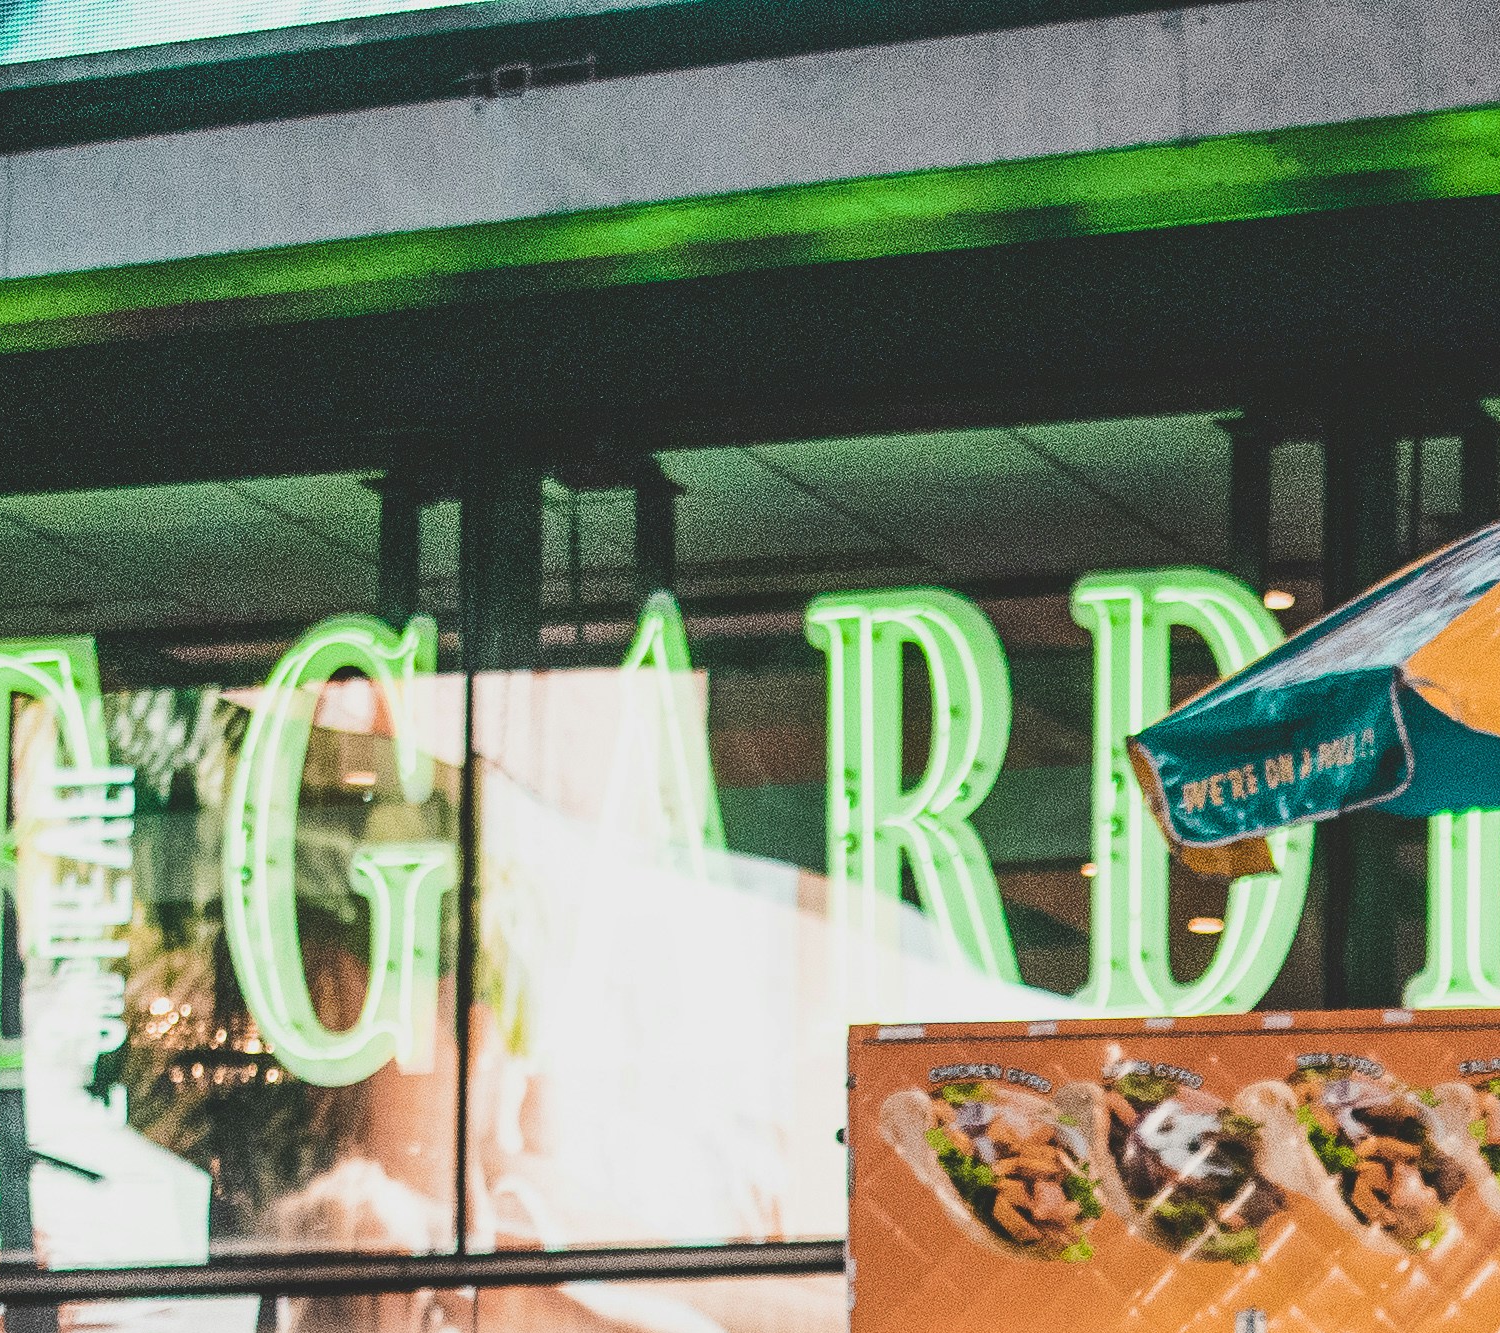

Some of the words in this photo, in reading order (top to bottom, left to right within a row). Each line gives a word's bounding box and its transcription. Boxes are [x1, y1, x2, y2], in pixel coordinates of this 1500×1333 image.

[928, 1062, 1001, 1084] CHICKEN
[1004, 1066, 1051, 1093] GYRO
[1337, 1053, 1382, 1077] GYRO
